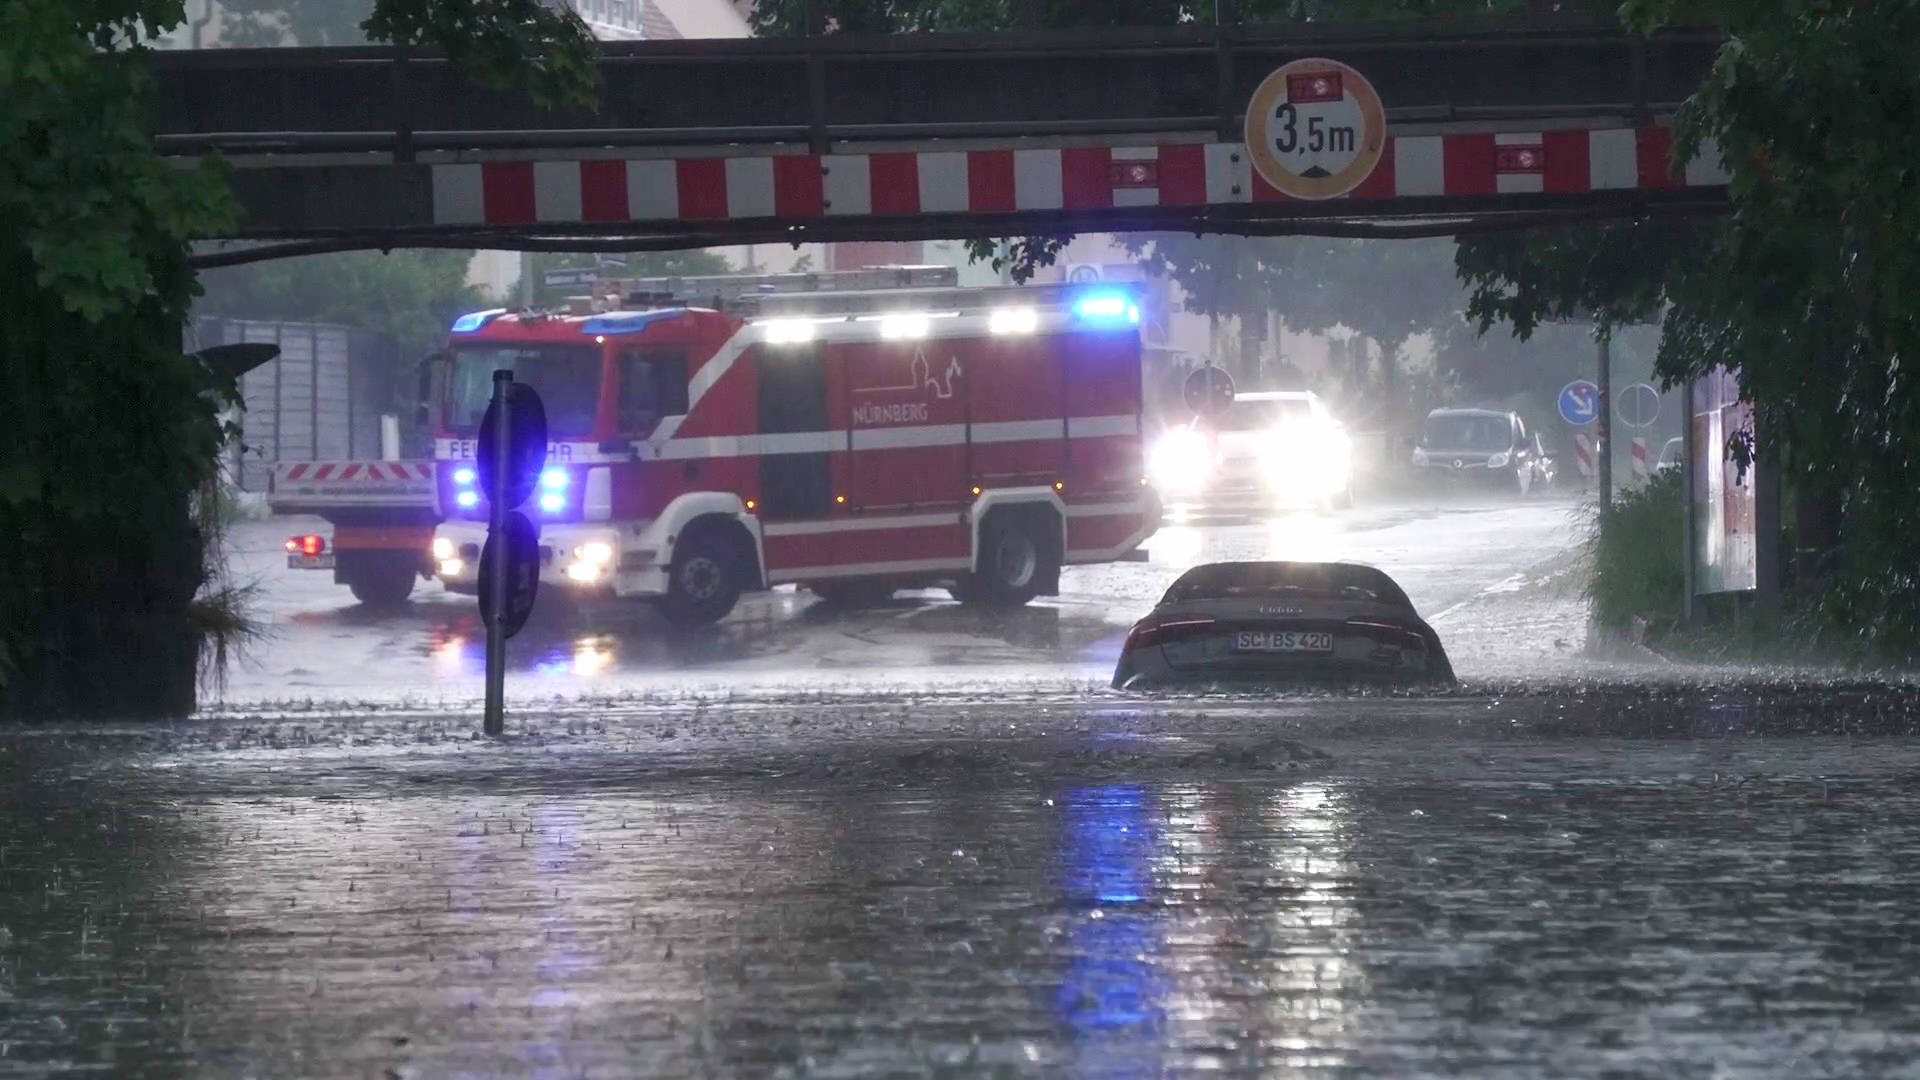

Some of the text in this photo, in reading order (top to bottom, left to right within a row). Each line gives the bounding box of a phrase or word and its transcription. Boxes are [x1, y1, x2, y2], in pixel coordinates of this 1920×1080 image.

[1275, 103, 1354, 154] 3,5m
[853, 402, 928, 424] NÜRNBERG
[1240, 632, 1331, 649] SC BS 420
